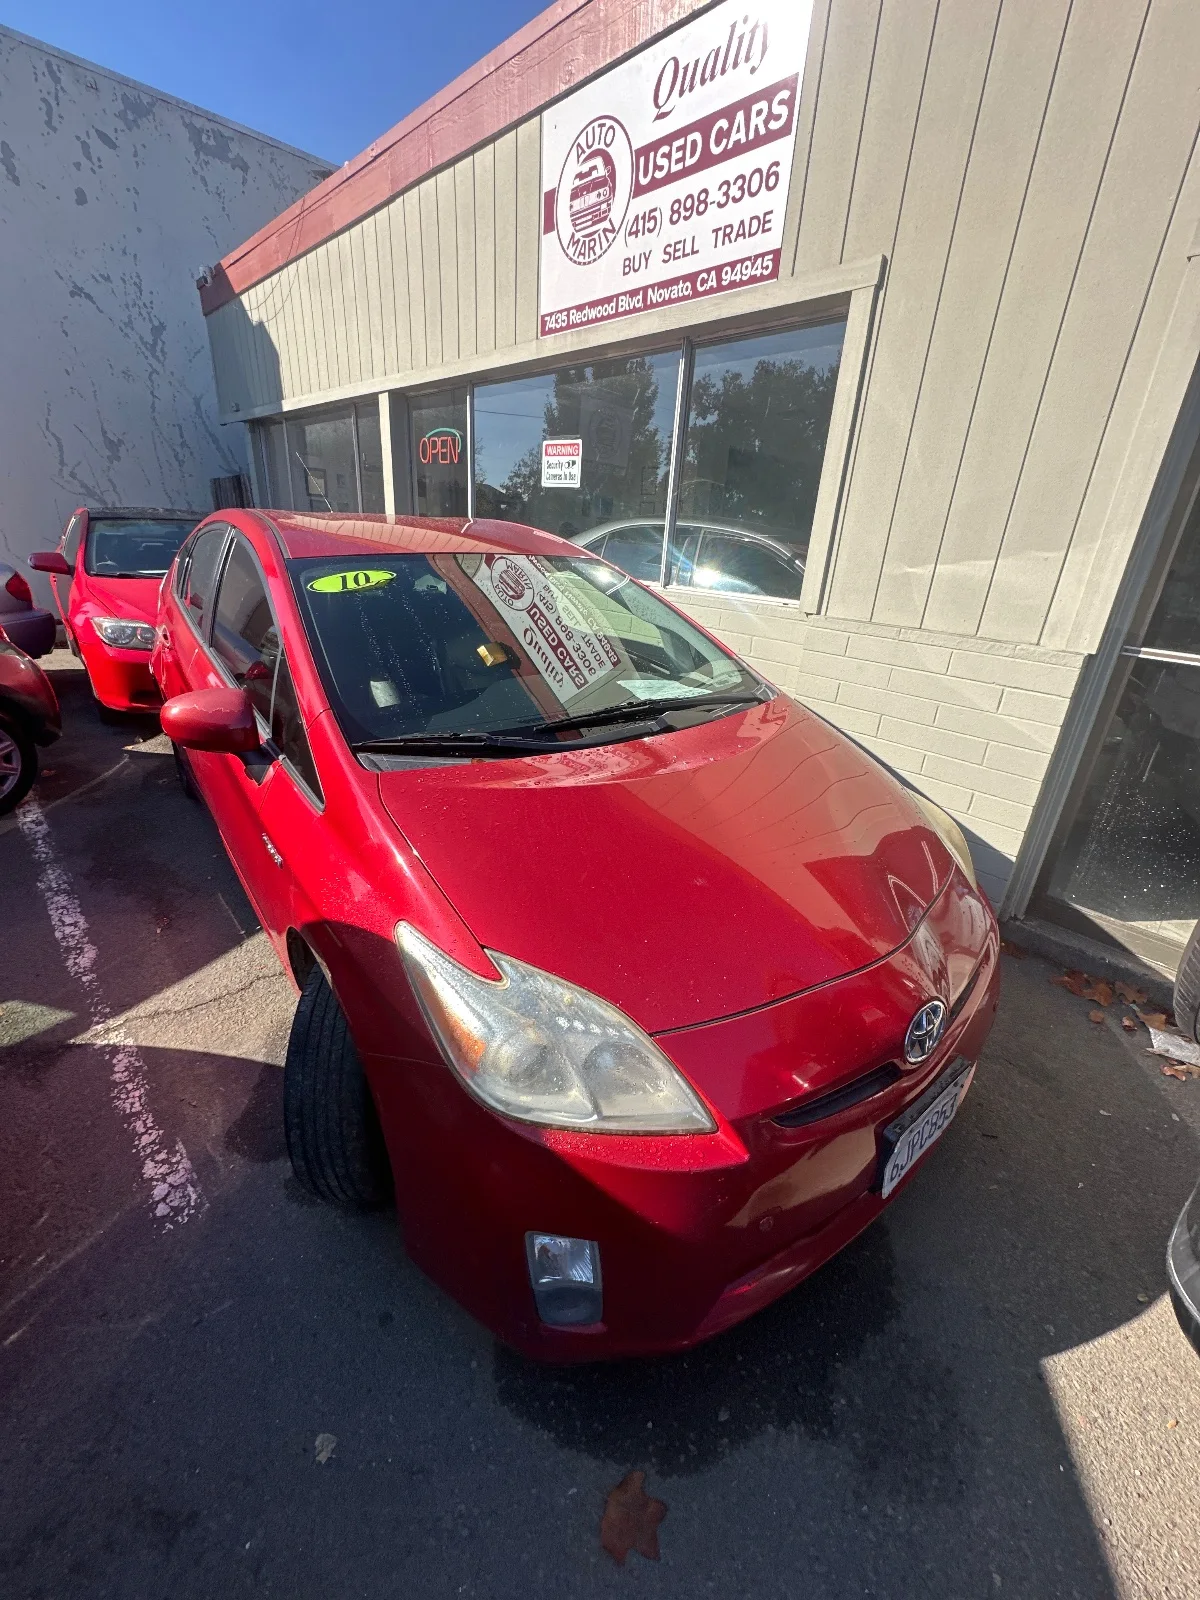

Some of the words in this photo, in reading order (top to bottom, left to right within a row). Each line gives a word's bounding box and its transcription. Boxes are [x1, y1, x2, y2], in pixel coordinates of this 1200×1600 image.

[652, 15, 769, 123] Quality
[575, 122, 615, 164] AUTO
[639, 131, 702, 186] USED
[709, 90, 791, 155] CARS
[624, 207, 663, 247] (415)
[669, 161, 780, 226] 898-3306
[566, 217, 616, 260] MARTIN
[622, 249, 652, 276] BUY
[661, 236, 699, 264] SELL
[711, 210, 773, 248] TRADE
[544, 311, 568, 331] 7435
[569, 299, 616, 325] Redwood
[618, 292, 643, 312] Blvd,
[647, 281, 693, 304] Novato,
[696, 272, 717, 291] CA
[721, 254, 773, 286] 94945
[420, 437, 459, 464] OPEN
[546, 460, 563, 471] Security
[547, 444, 579, 456] WARNING
[340, 571, 371, 591] 10
[890, 1093, 958, 1182] 6JPC853
